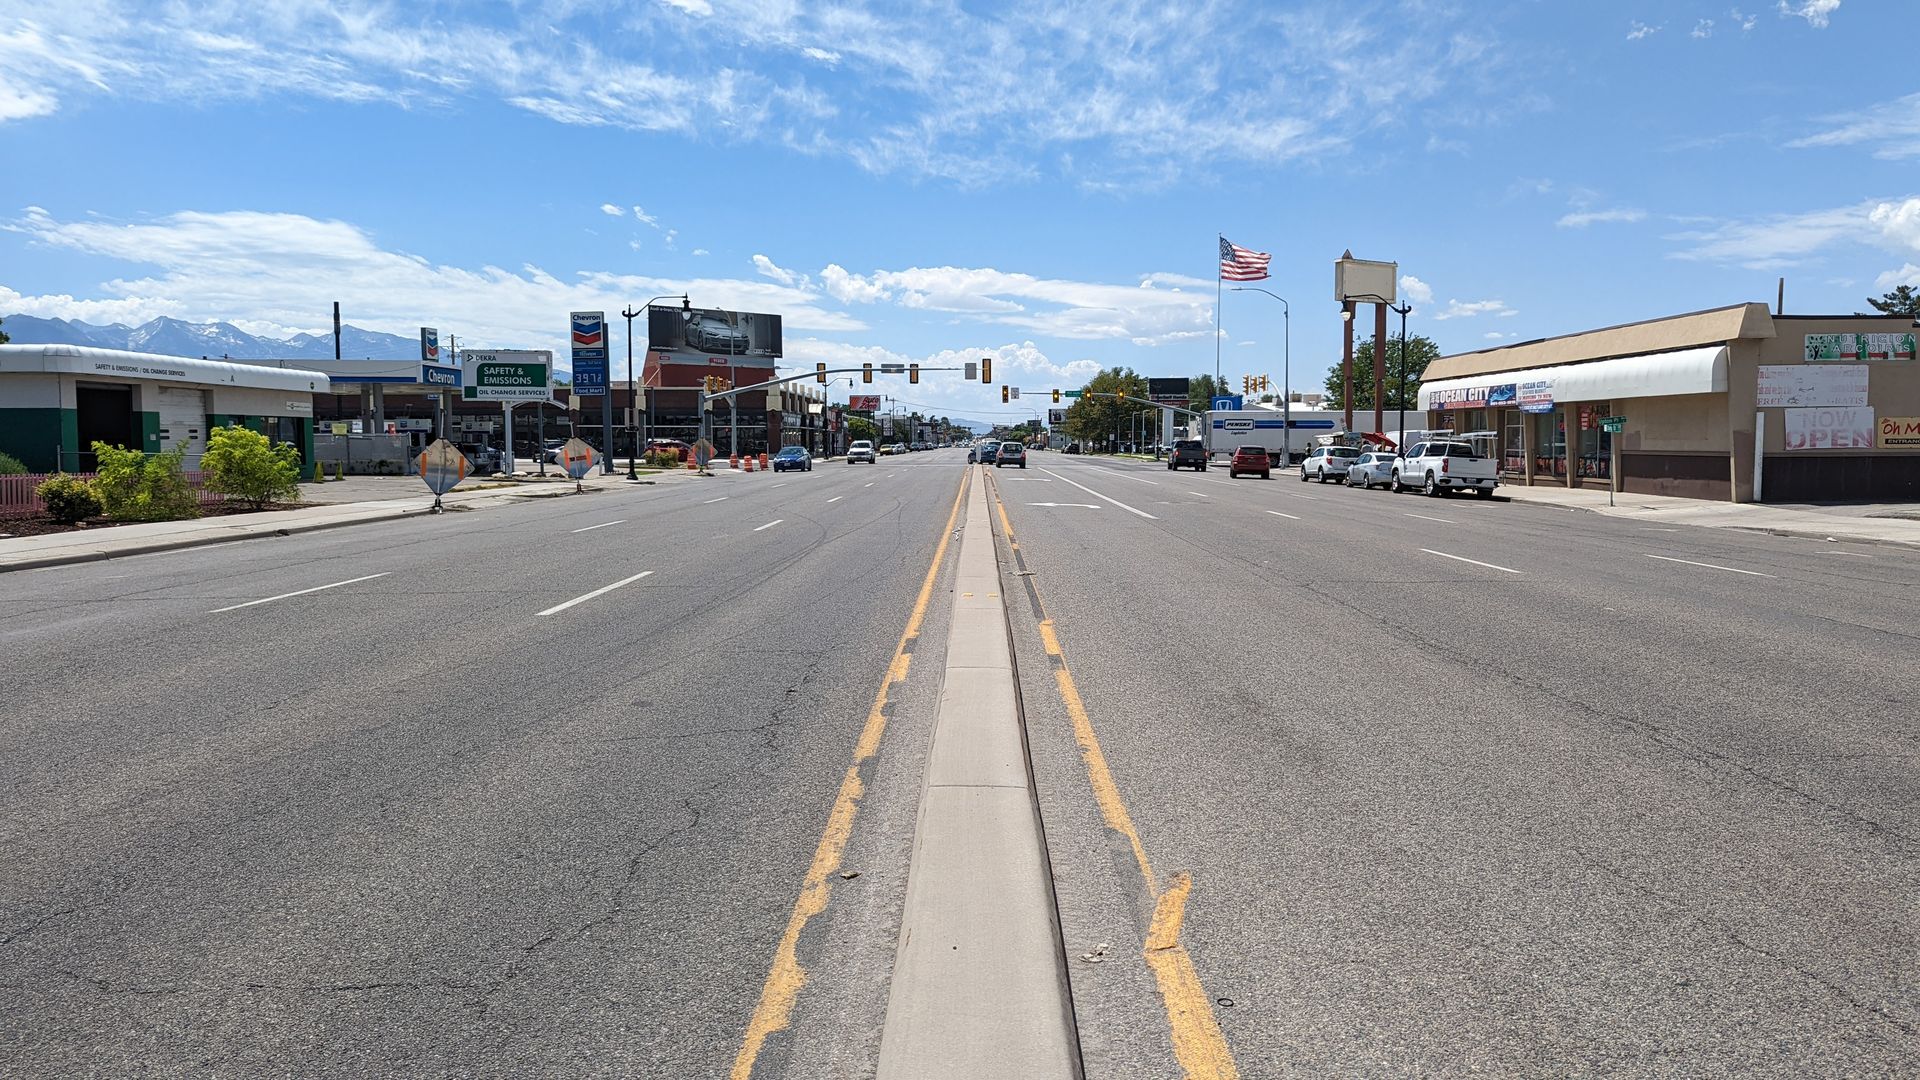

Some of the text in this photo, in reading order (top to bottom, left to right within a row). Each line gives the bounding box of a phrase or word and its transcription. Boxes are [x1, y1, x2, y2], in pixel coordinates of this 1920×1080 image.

[1827, 335, 1916, 343] NUTRICION
[1833, 344, 1910, 352] ARCOIRIS
[116, 365, 138, 373] EMISSIONS
[484, 367, 524, 375] SAFETY &
[428, 369, 455, 385] Chevron
[1440, 388, 1467, 403] OCEAN
[1468, 386, 1491, 401] CITY
[1802, 411, 1856, 428] NOW
[1883, 421, 1900, 435] Oh
[1787, 428, 1872, 448] OPEN
